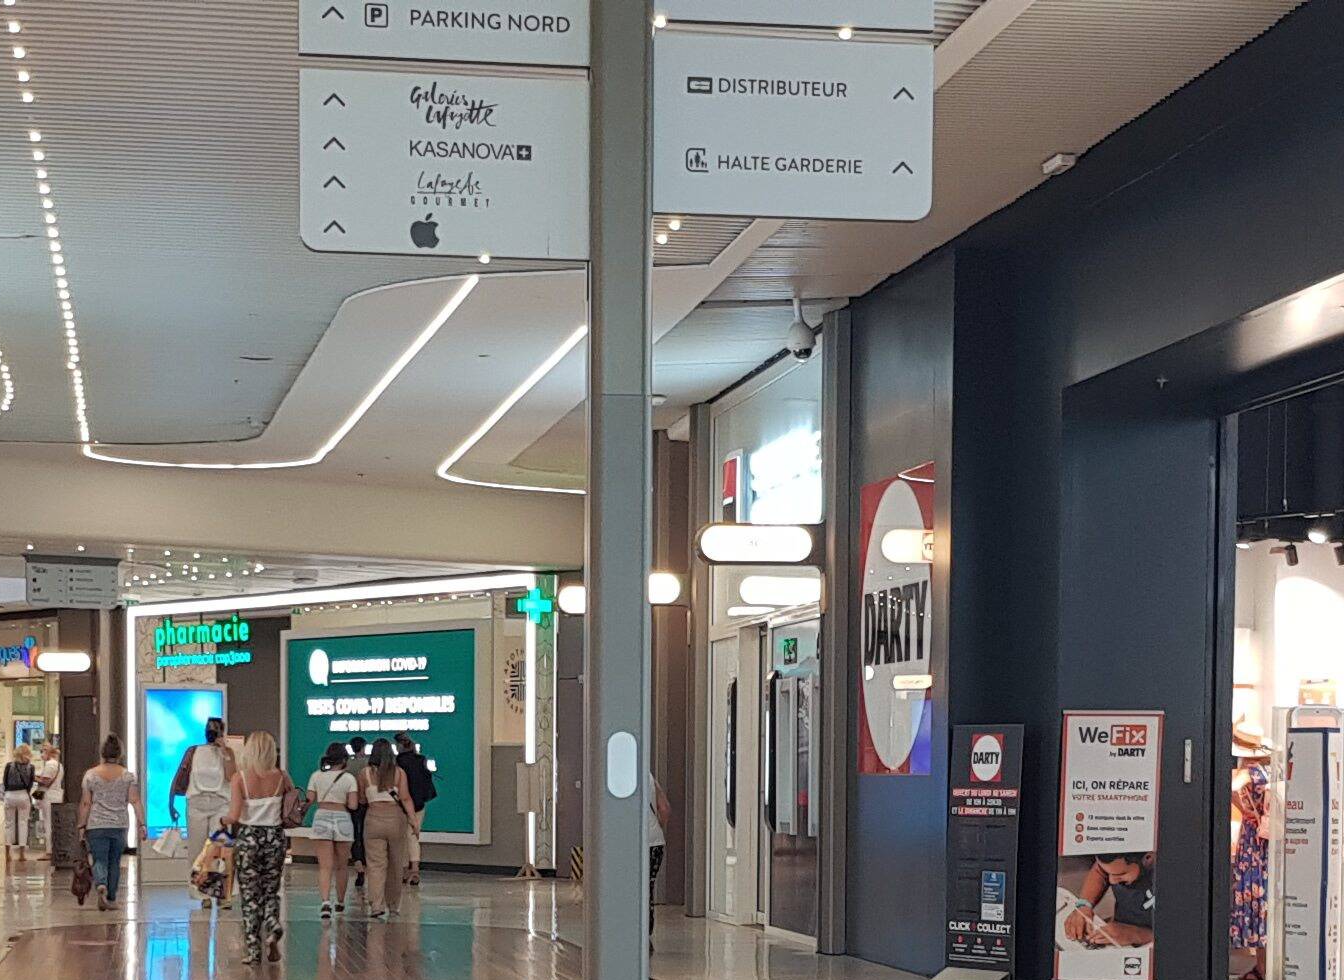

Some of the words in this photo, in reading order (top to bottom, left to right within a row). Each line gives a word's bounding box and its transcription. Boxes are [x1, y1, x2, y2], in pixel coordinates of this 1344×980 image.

[410, 9, 502, 30] PARKING
[508, 14, 570, 33] NORD
[718, 77, 847, 97] DISTRIBUTEUR
[717, 154, 770, 171] HALTE
[774, 157, 863, 174] GARDERIE
[410, 195, 490, 207] GOURMET
[864, 580, 928, 666] DARTY
[155, 615, 249, 653] pharmacie
[973, 751, 1000, 765] DARTY
[1118, 748, 1145, 757] DARTY
[1072, 780, 1088, 791] ICI,
[1091, 781, 1106, 790] ON
[1109, 779, 1150, 790] RÉPARE
[949, 921, 970, 930] CLICK
[977, 923, 1011, 934] COLLECT
